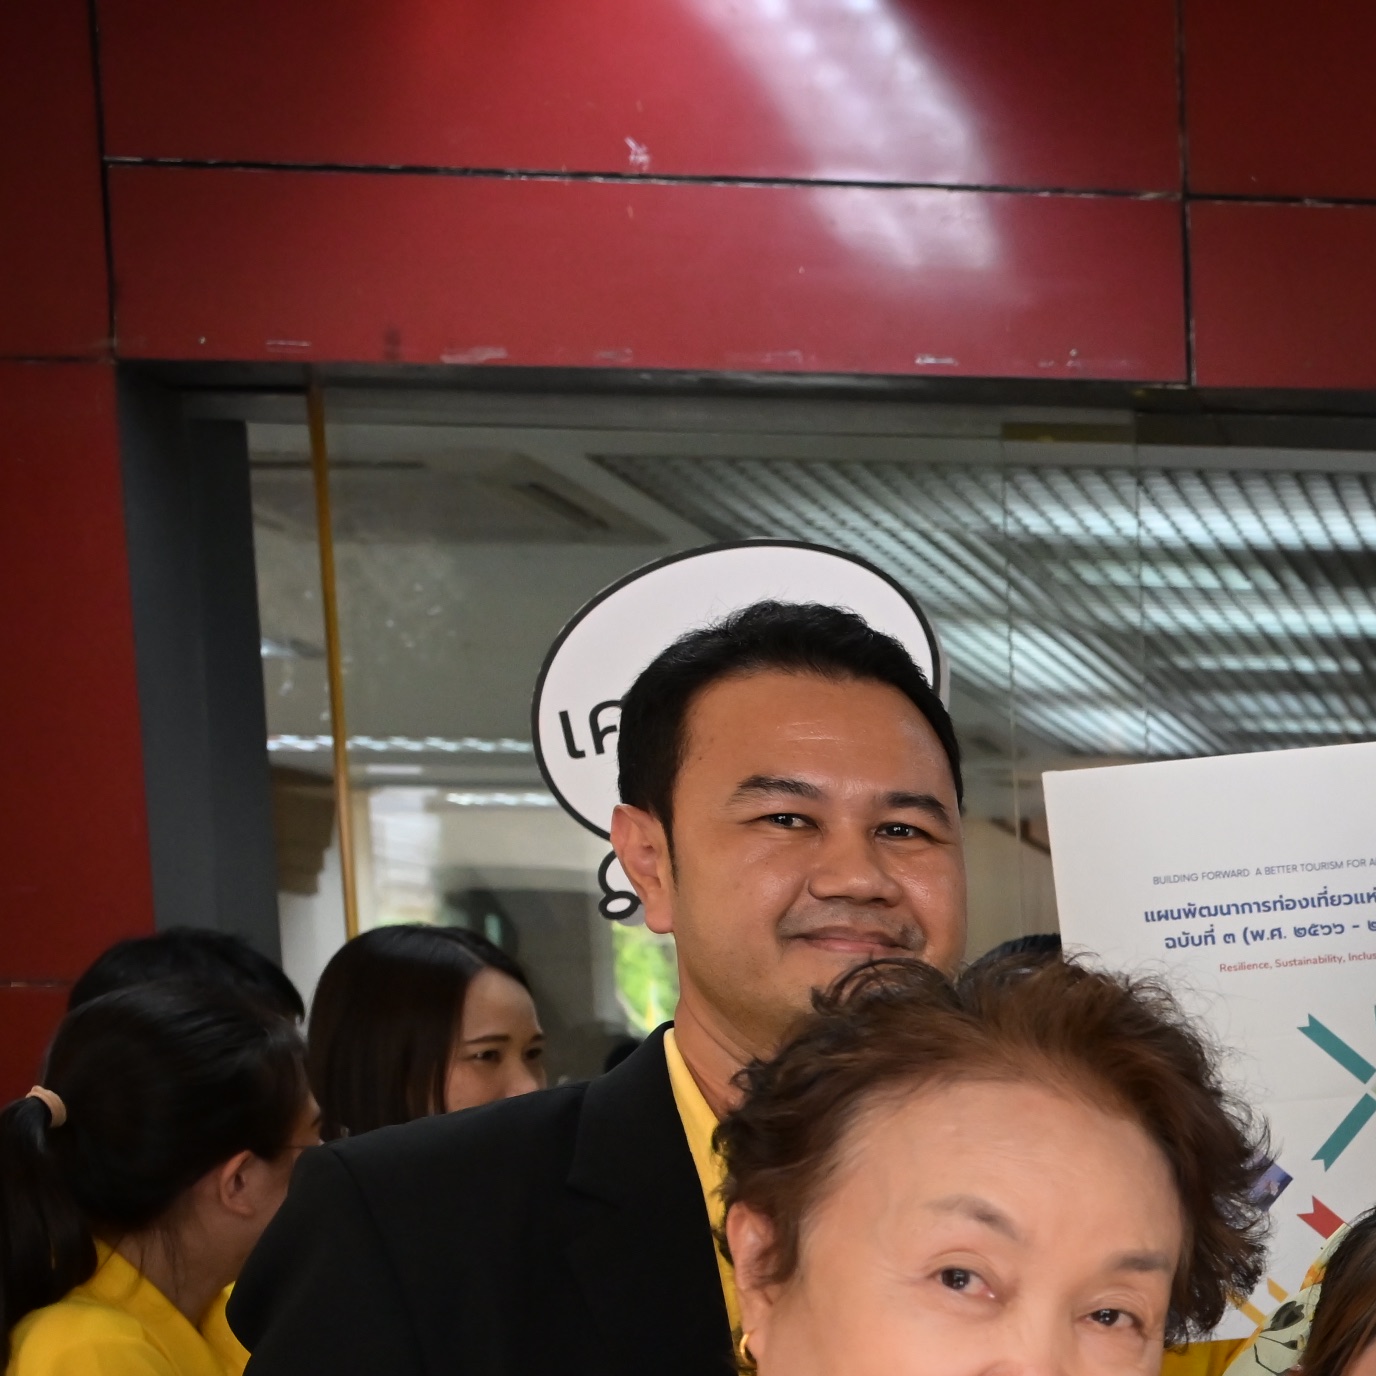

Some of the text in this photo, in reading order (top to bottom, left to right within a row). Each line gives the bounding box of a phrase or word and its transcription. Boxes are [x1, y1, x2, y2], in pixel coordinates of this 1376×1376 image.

[1152, 872, 1199, 886] BUILDING
[1201, 867, 1250, 881] FORWARD
[1255, 867, 1263, 877] A
[1264, 863, 1298, 876] BETTER
[1300, 860, 1344, 873] TOURISM
[1346, 858, 1366, 869] FOR
[1164, 924, 1216, 949] ฉบับที่
[1223, 932, 1236, 944] ๓
[1242, 926, 1287, 946] (พ.ศ.
[1293, 922, 1345, 938] ๒๕๖๖
[1219, 960, 1273, 973] Resilience,
[1274, 953, 1346, 969] Sustainability,
